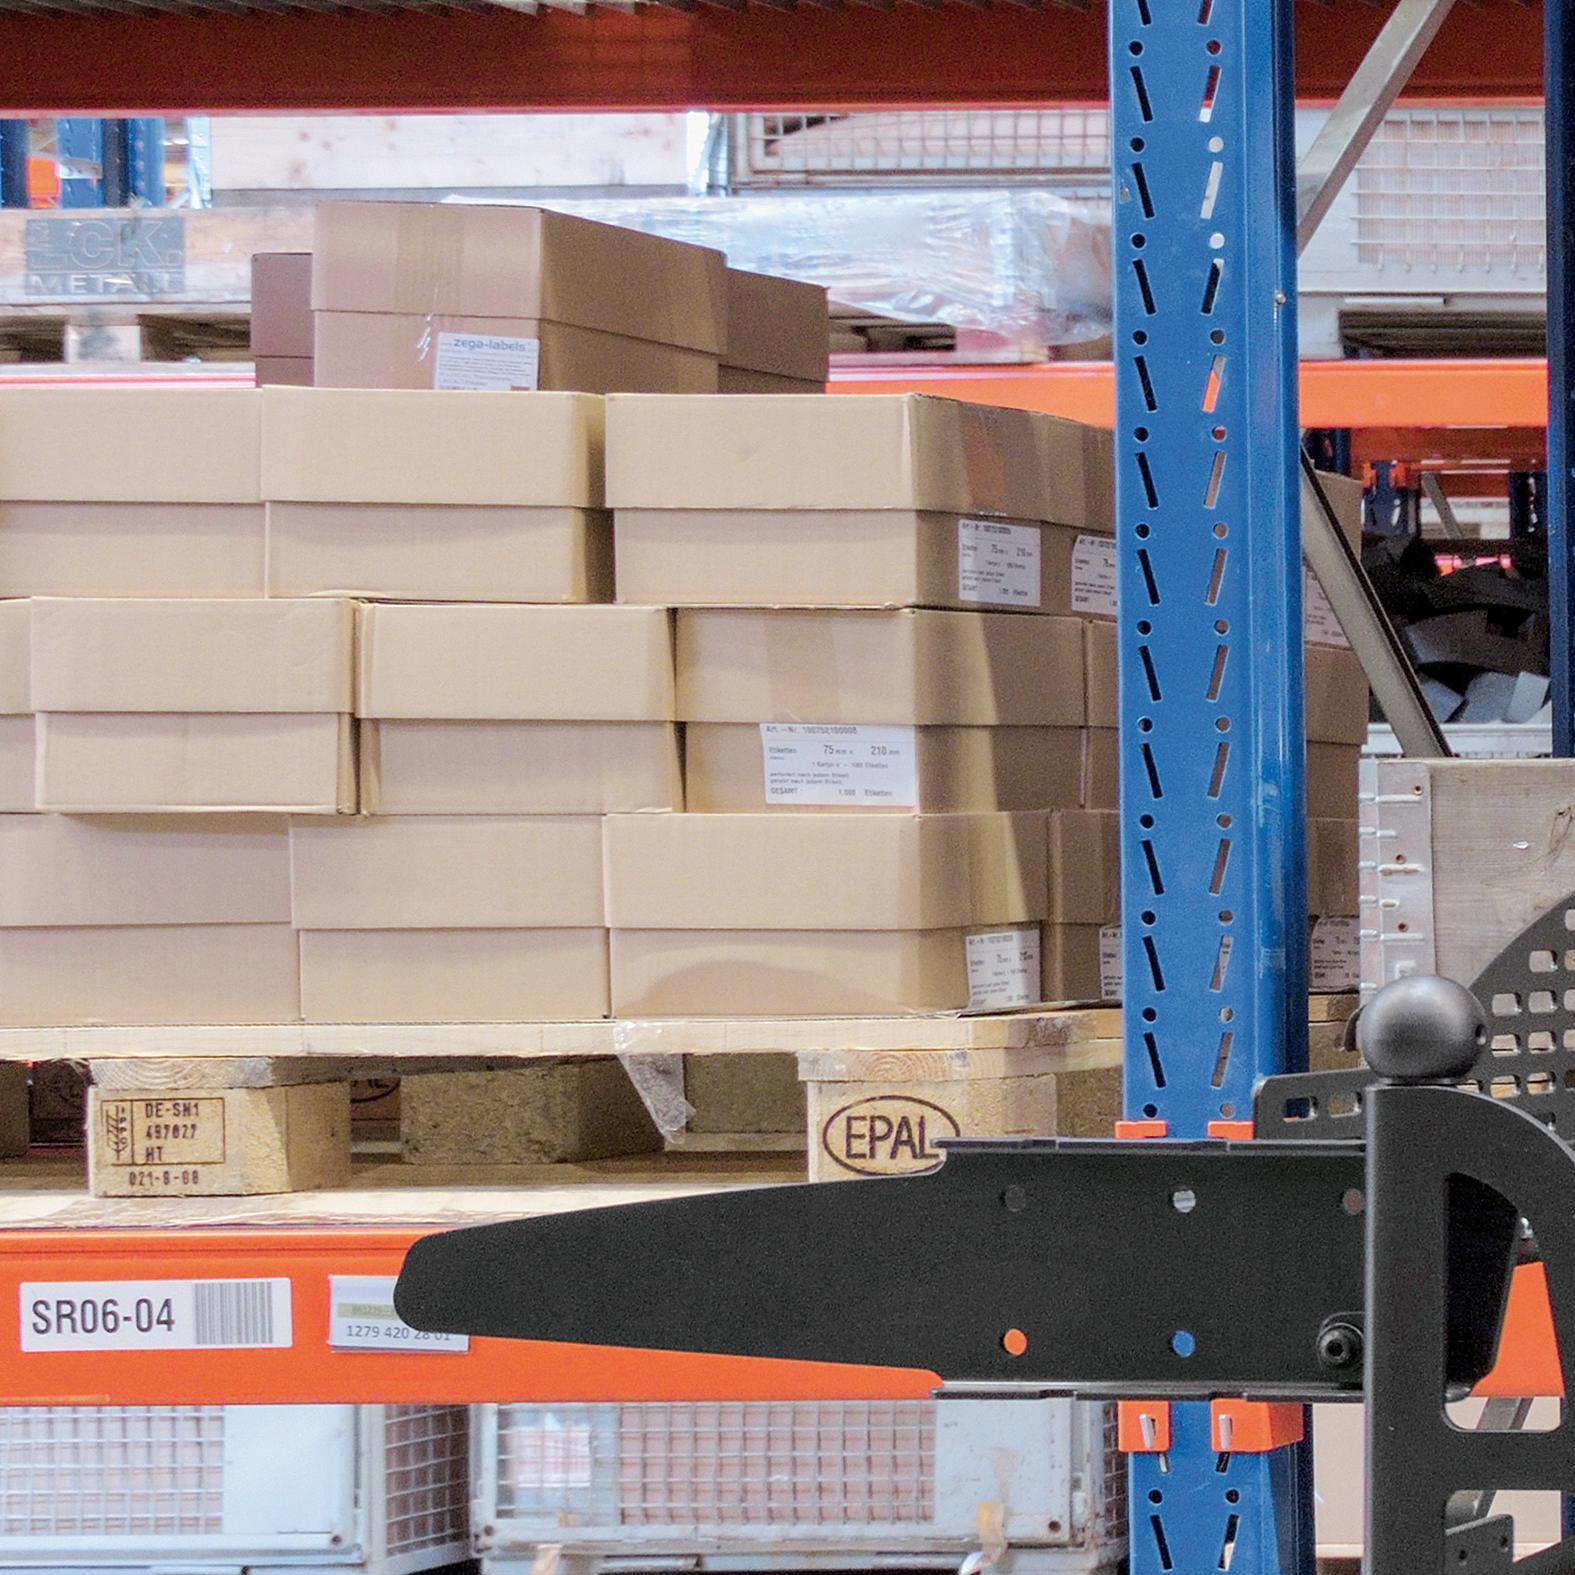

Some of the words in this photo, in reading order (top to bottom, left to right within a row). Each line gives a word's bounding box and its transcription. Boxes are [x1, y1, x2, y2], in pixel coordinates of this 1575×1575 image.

[845, 1114, 940, 1160] EPAL
[31, 1297, 175, 1335] SR06-04
[346, 1325, 380, 1339] 1279
[384, 1327, 410, 1339] 420
